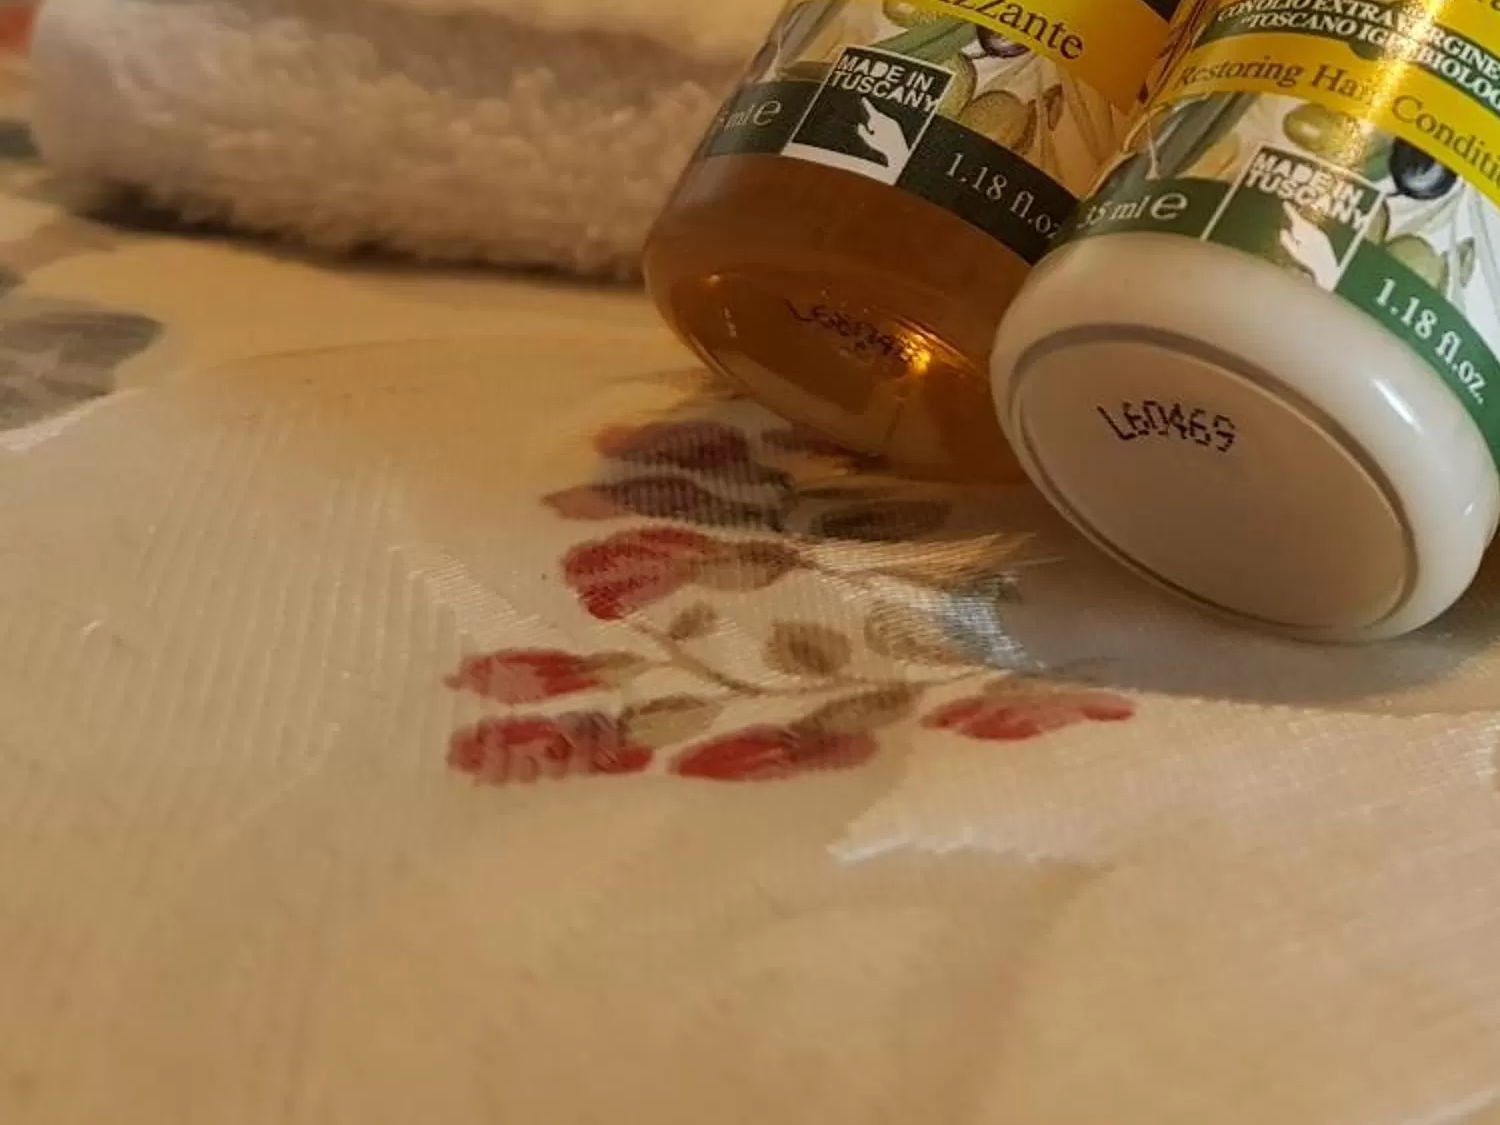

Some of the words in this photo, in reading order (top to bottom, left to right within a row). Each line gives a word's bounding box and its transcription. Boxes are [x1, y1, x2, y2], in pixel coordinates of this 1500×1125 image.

[828, 70, 943, 114] TUSCANY
[836, 53, 901, 85] MADE
[903, 69, 934, 93] IN
[945, 151, 1009, 202] 1.18
[1245, 170, 1371, 231] TUSCANY
[1251, 152, 1333, 191] MADE
[1331, 178, 1366, 209] IN
[1371, 277, 1439, 340] 1.18
